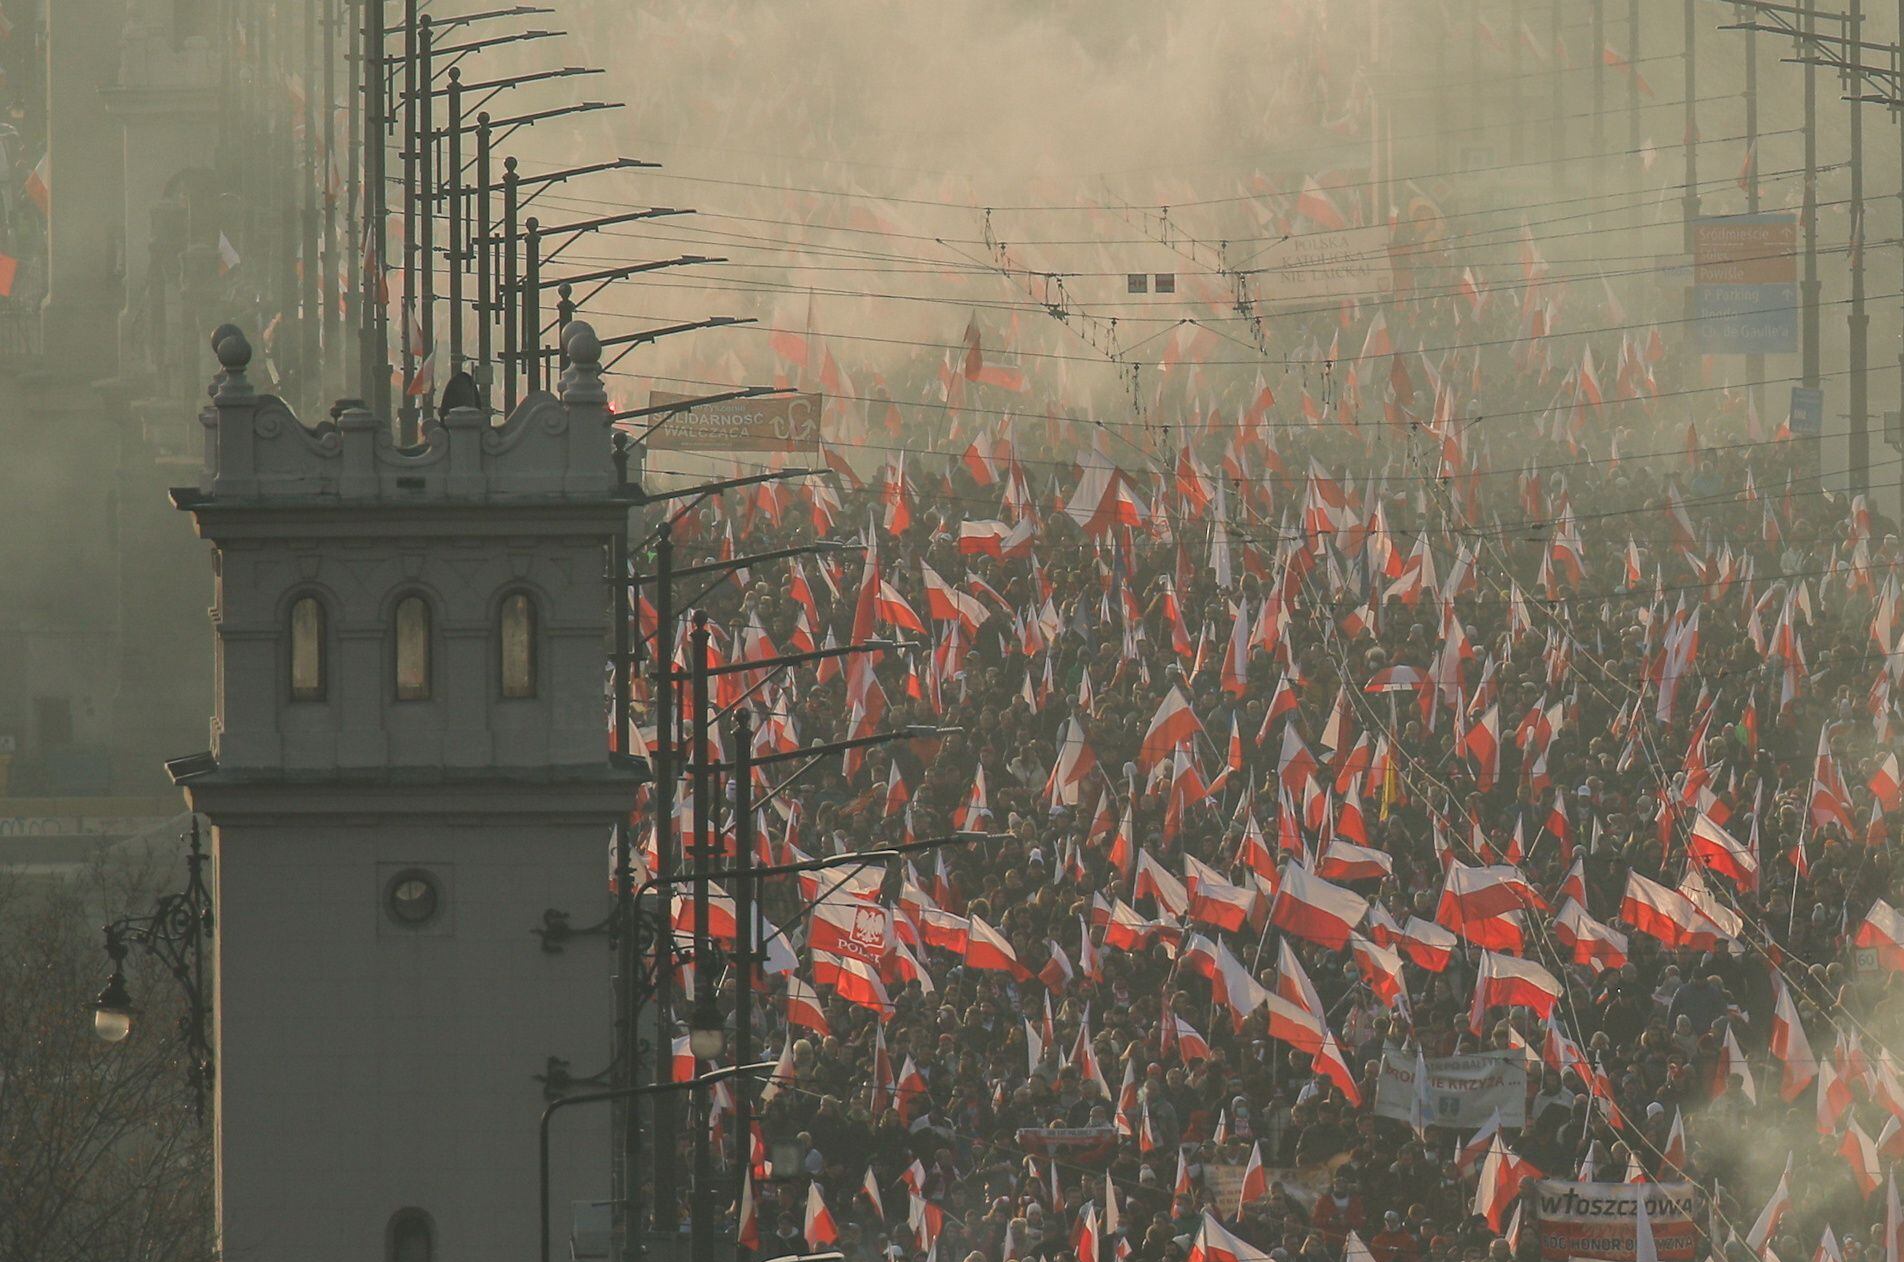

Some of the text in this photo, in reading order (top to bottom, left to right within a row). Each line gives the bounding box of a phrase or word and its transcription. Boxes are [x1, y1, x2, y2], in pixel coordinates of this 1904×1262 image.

[1294, 235, 1350, 251] POLSKA
[1280, 271, 1306, 284] NIE
[1716, 288, 1760, 304] Parking
[1723, 325, 1738, 337] de
[1858, 954, 1874, 966] 60
[1570, 1237, 1621, 1250] HONOR
